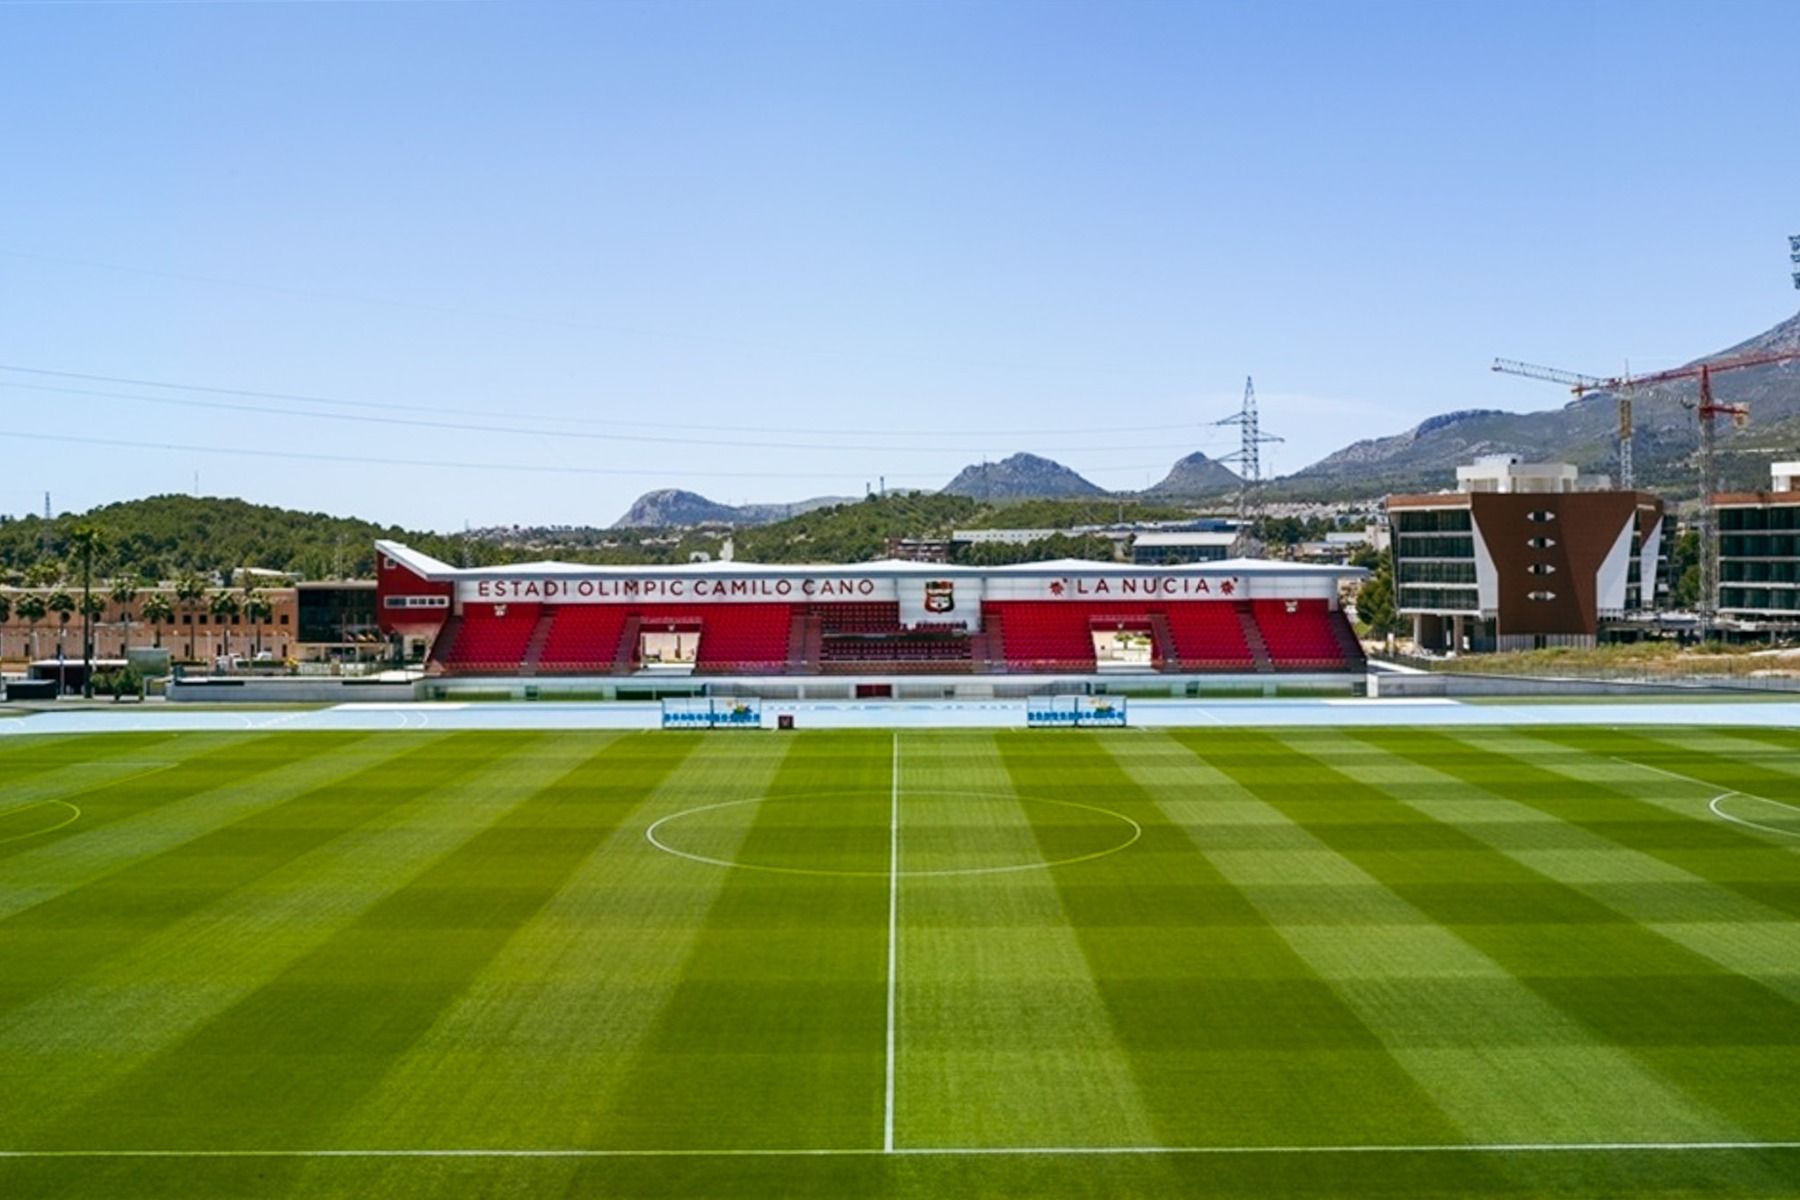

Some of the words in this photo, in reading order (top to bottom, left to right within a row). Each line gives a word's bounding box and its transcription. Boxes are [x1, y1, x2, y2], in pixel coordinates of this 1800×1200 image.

[478, 580, 567, 597] ESTADI
[578, 579, 685, 596] OLIMPIC
[694, 579, 792, 596] CAMILO
[802, 578, 875, 595] CANO
[1077, 578, 1110, 594] LA
[1123, 577, 1210, 594] NUCIA
